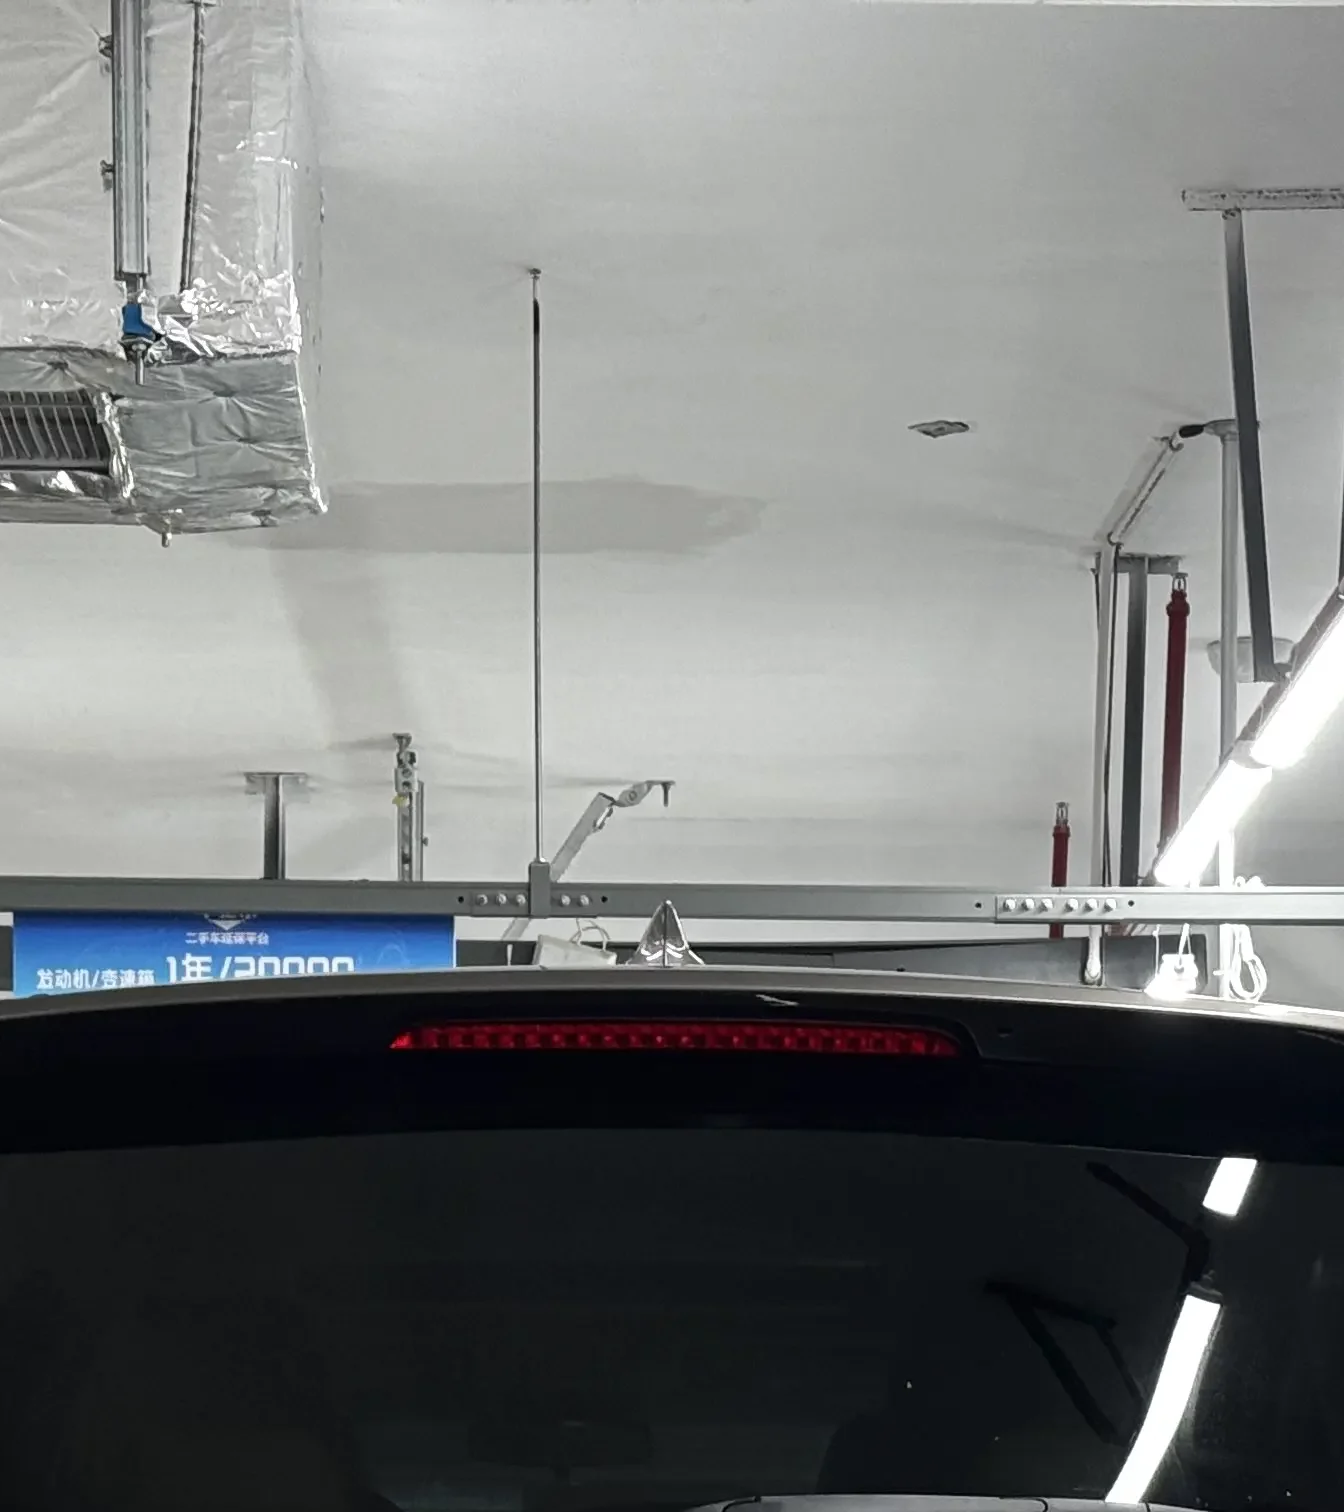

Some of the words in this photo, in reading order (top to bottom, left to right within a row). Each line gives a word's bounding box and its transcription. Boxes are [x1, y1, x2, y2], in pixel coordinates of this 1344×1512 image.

[36, 967, 156, 990] 发动机/变速箱
